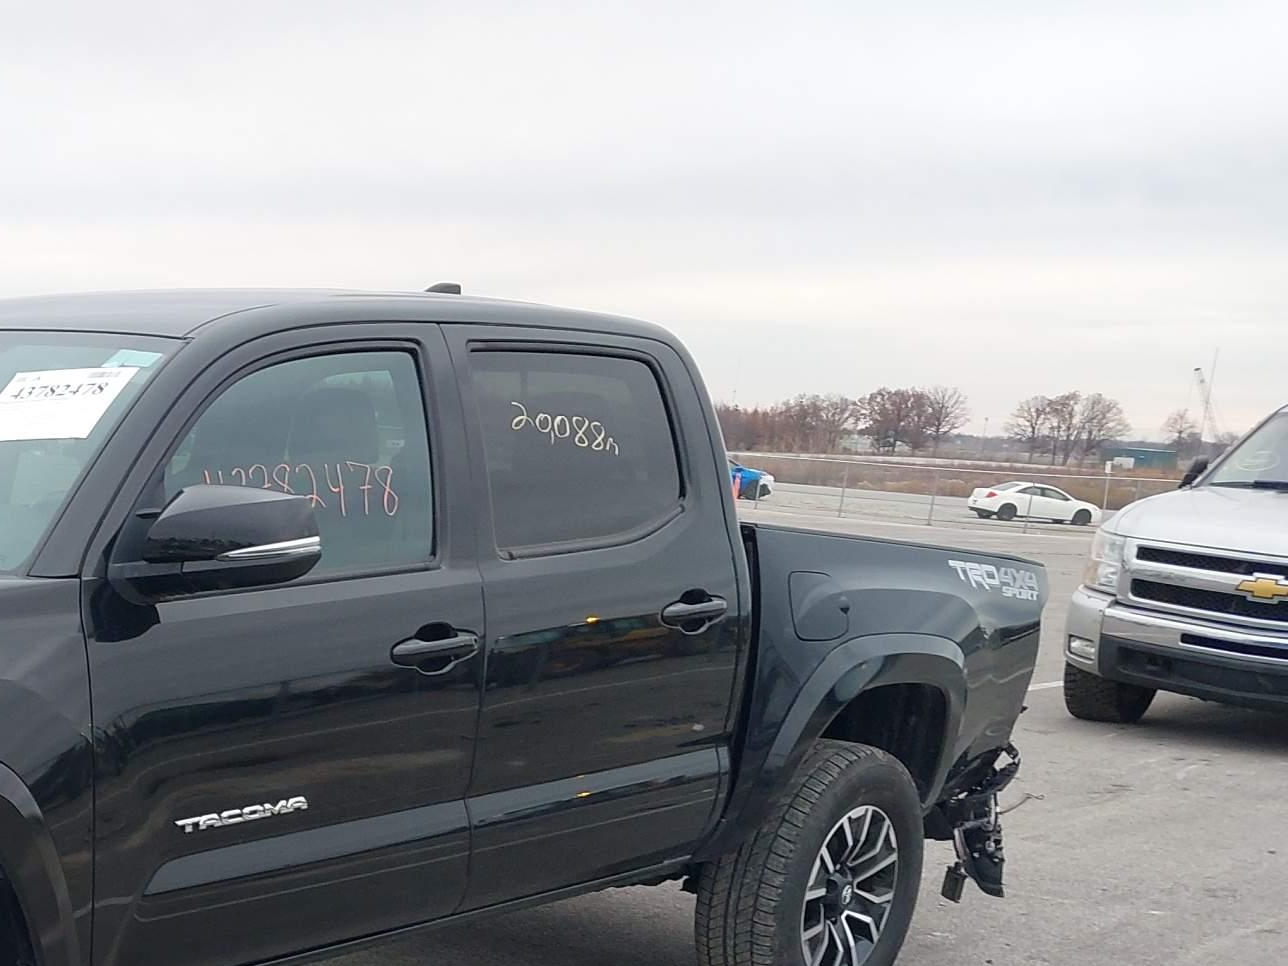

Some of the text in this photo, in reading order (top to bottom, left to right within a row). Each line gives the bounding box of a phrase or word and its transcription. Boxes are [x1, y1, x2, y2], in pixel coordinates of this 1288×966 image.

[11, 381, 109, 400] 43782478
[948, 559, 1001, 592] TRD
[1001, 586, 1039, 601] SPORT
[174, 796, 309, 833] TACOMA
